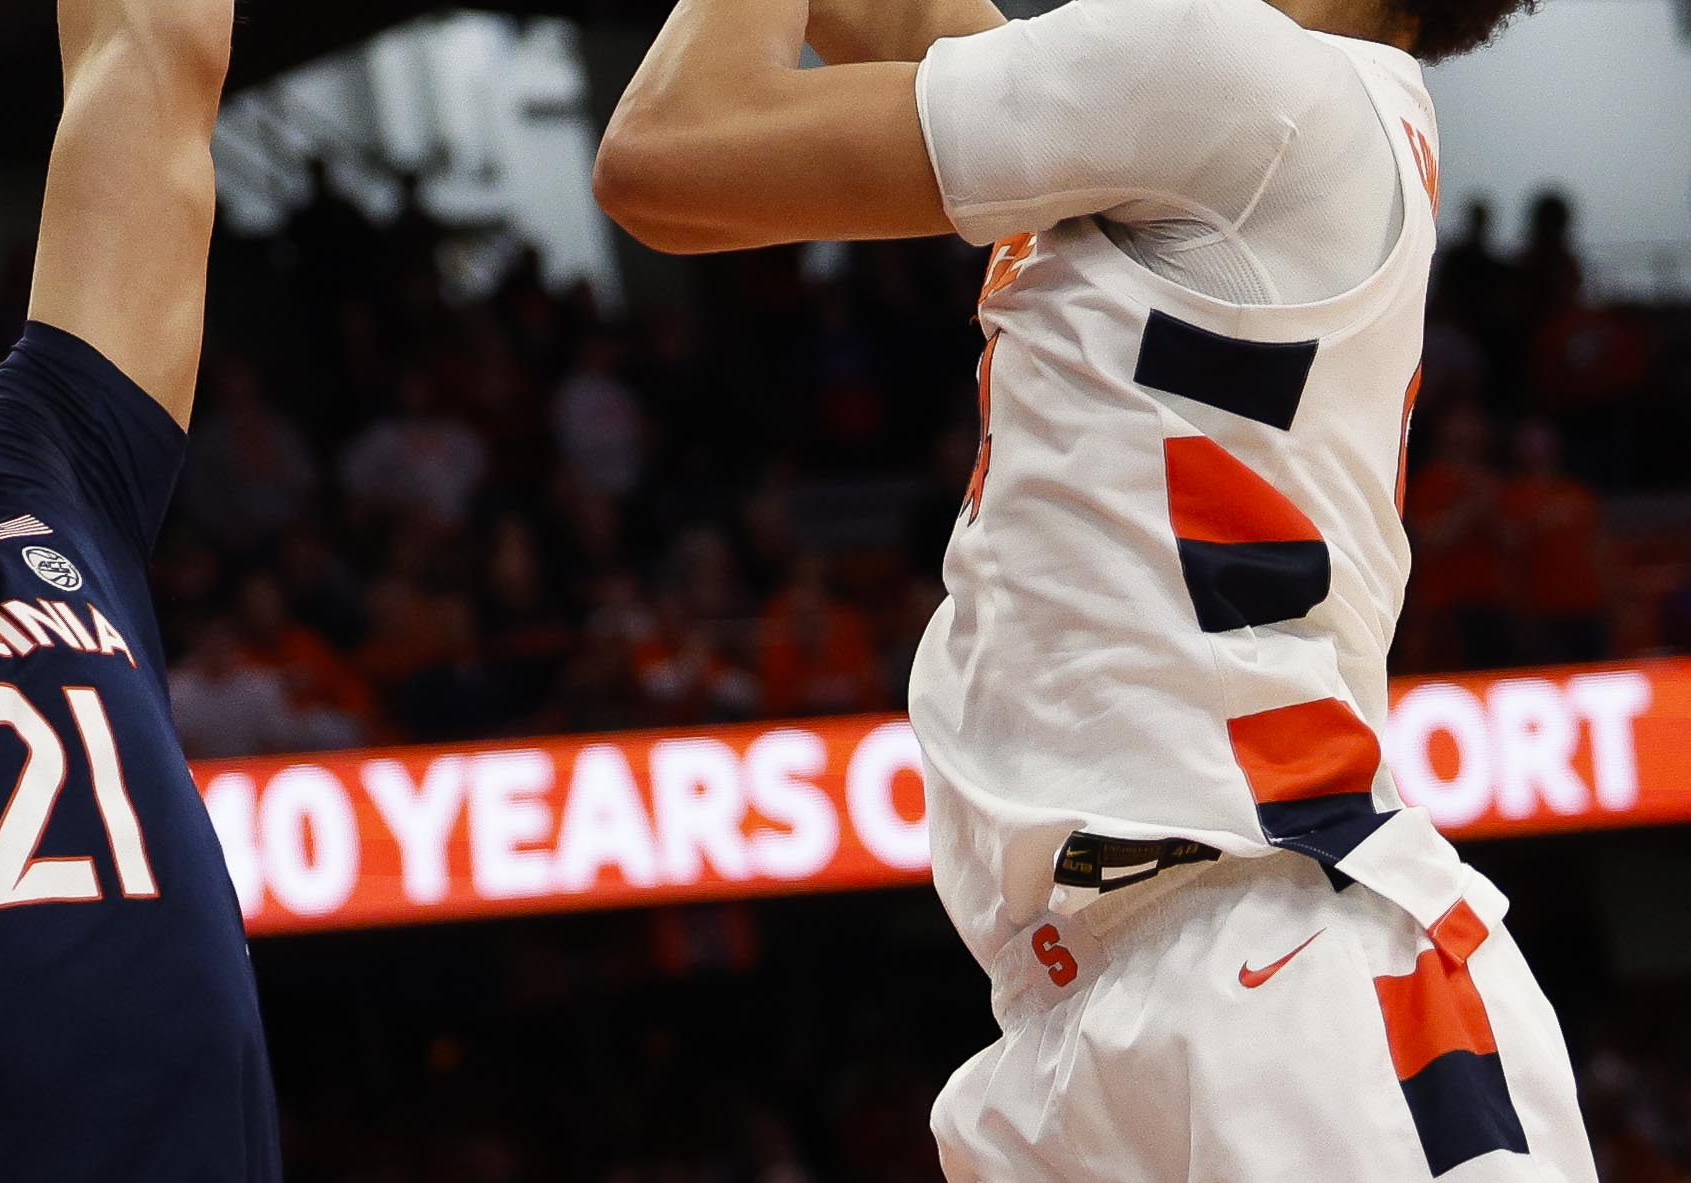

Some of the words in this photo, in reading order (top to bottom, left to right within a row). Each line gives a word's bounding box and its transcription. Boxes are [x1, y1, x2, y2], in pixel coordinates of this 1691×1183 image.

[360, 728, 840, 902] YEARS
[1381, 670, 1653, 827] ORT
[1031, 923, 1079, 988] S
